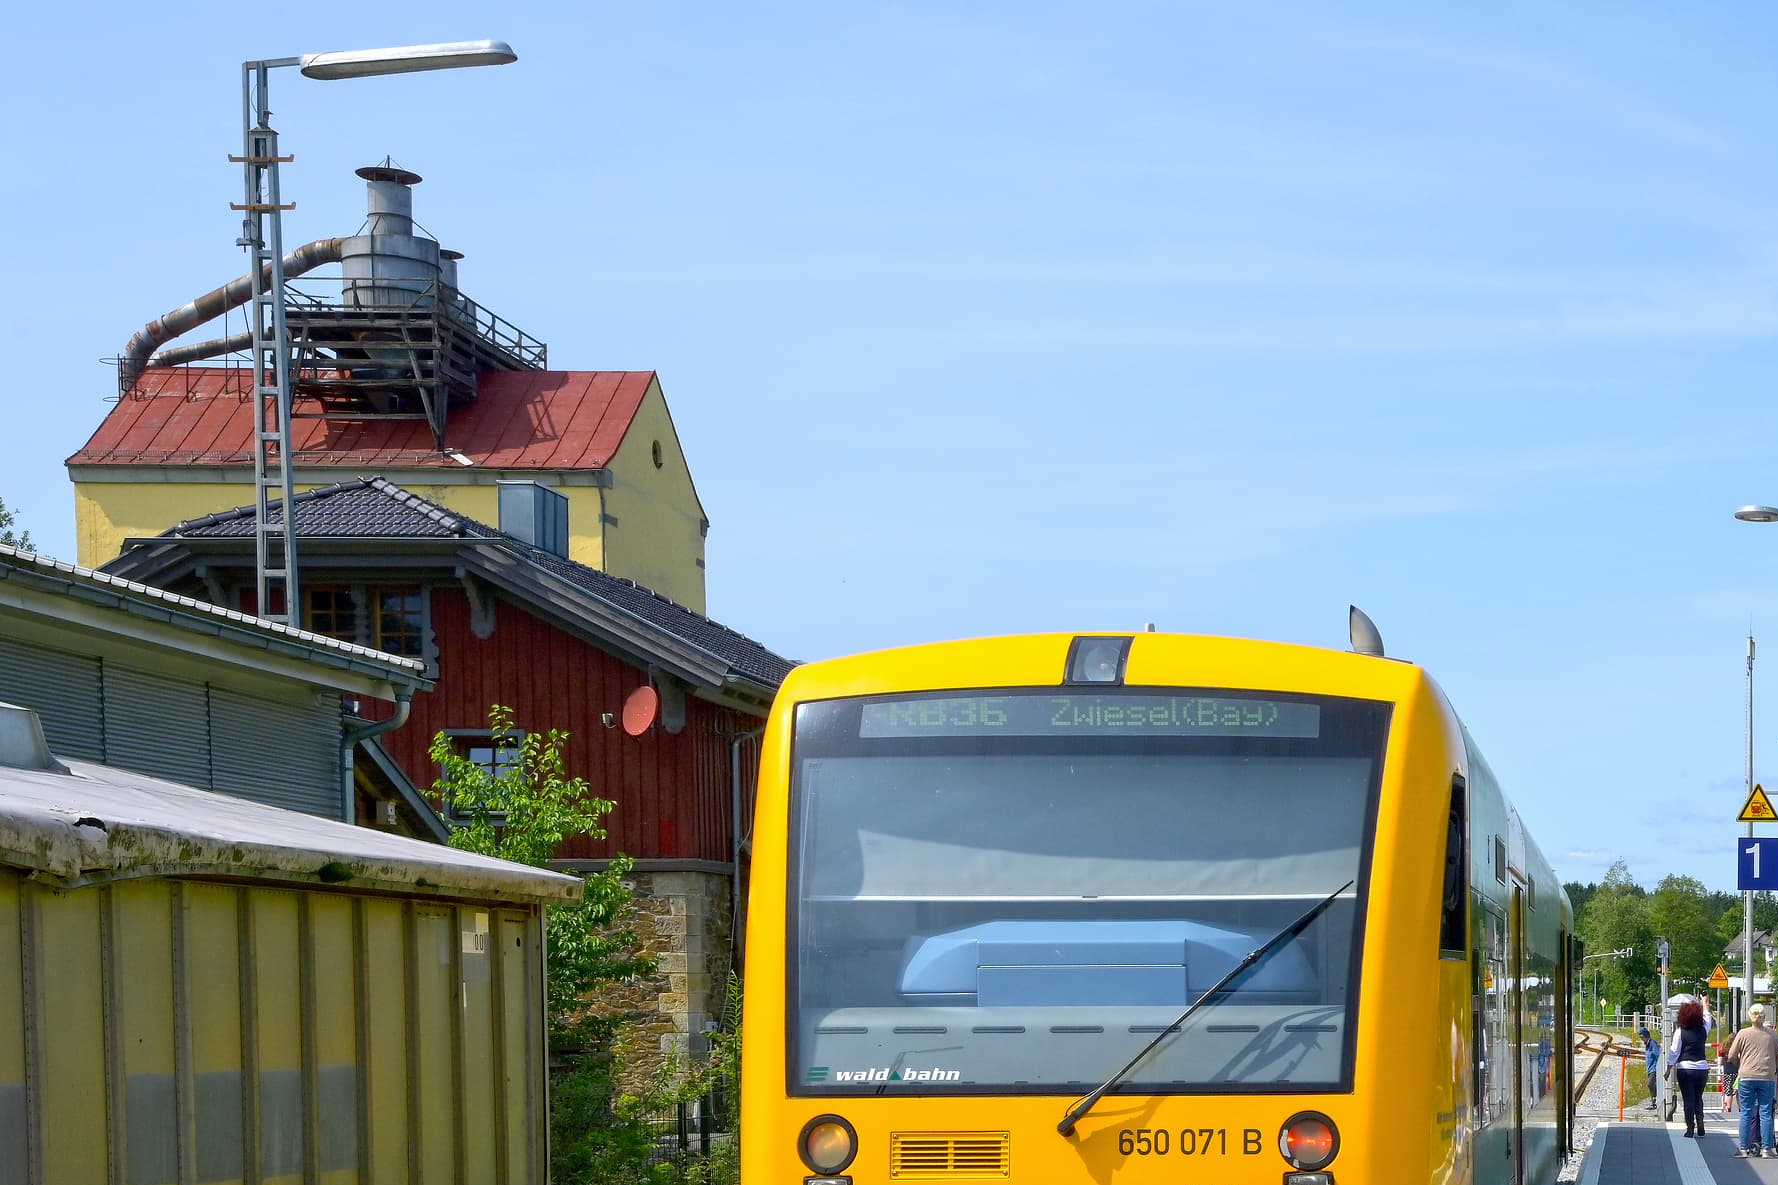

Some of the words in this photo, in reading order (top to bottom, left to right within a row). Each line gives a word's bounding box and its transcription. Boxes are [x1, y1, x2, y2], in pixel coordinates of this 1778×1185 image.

[1745, 842, 1760, 879] 1
[1118, 1128, 1170, 1156] 650
[1180, 1128, 1226, 1155] 071
[1243, 1128, 1262, 1155] B
